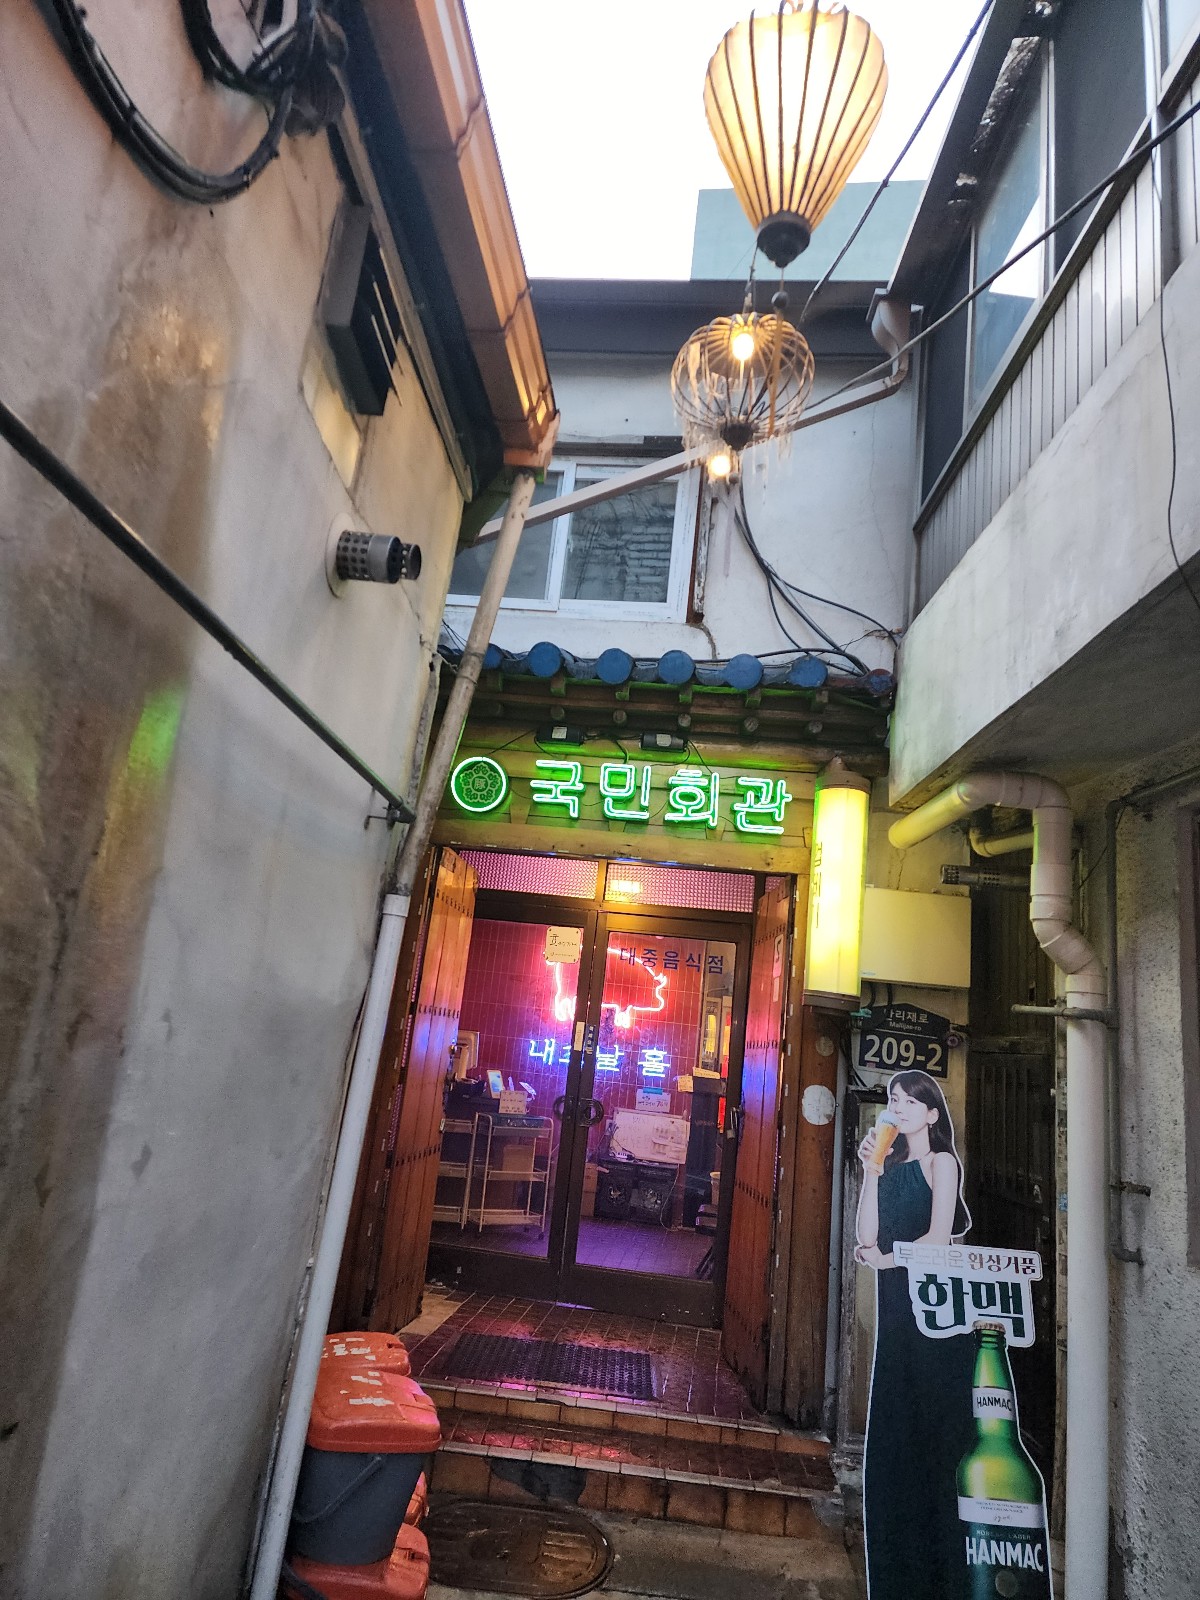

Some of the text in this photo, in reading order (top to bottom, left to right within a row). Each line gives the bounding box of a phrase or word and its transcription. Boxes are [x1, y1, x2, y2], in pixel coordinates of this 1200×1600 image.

[530, 759, 793, 835] 국민회관
[620, 946, 724, 975] 대중음식점
[864, 1034, 943, 1072] 209-2
[898, 1246, 964, 1269] 부드러운
[915, 1272, 1026, 1338] 한맥
[976, 1396, 1013, 1412] HANMAC
[965, 1535, 1045, 1573] HANMAC
